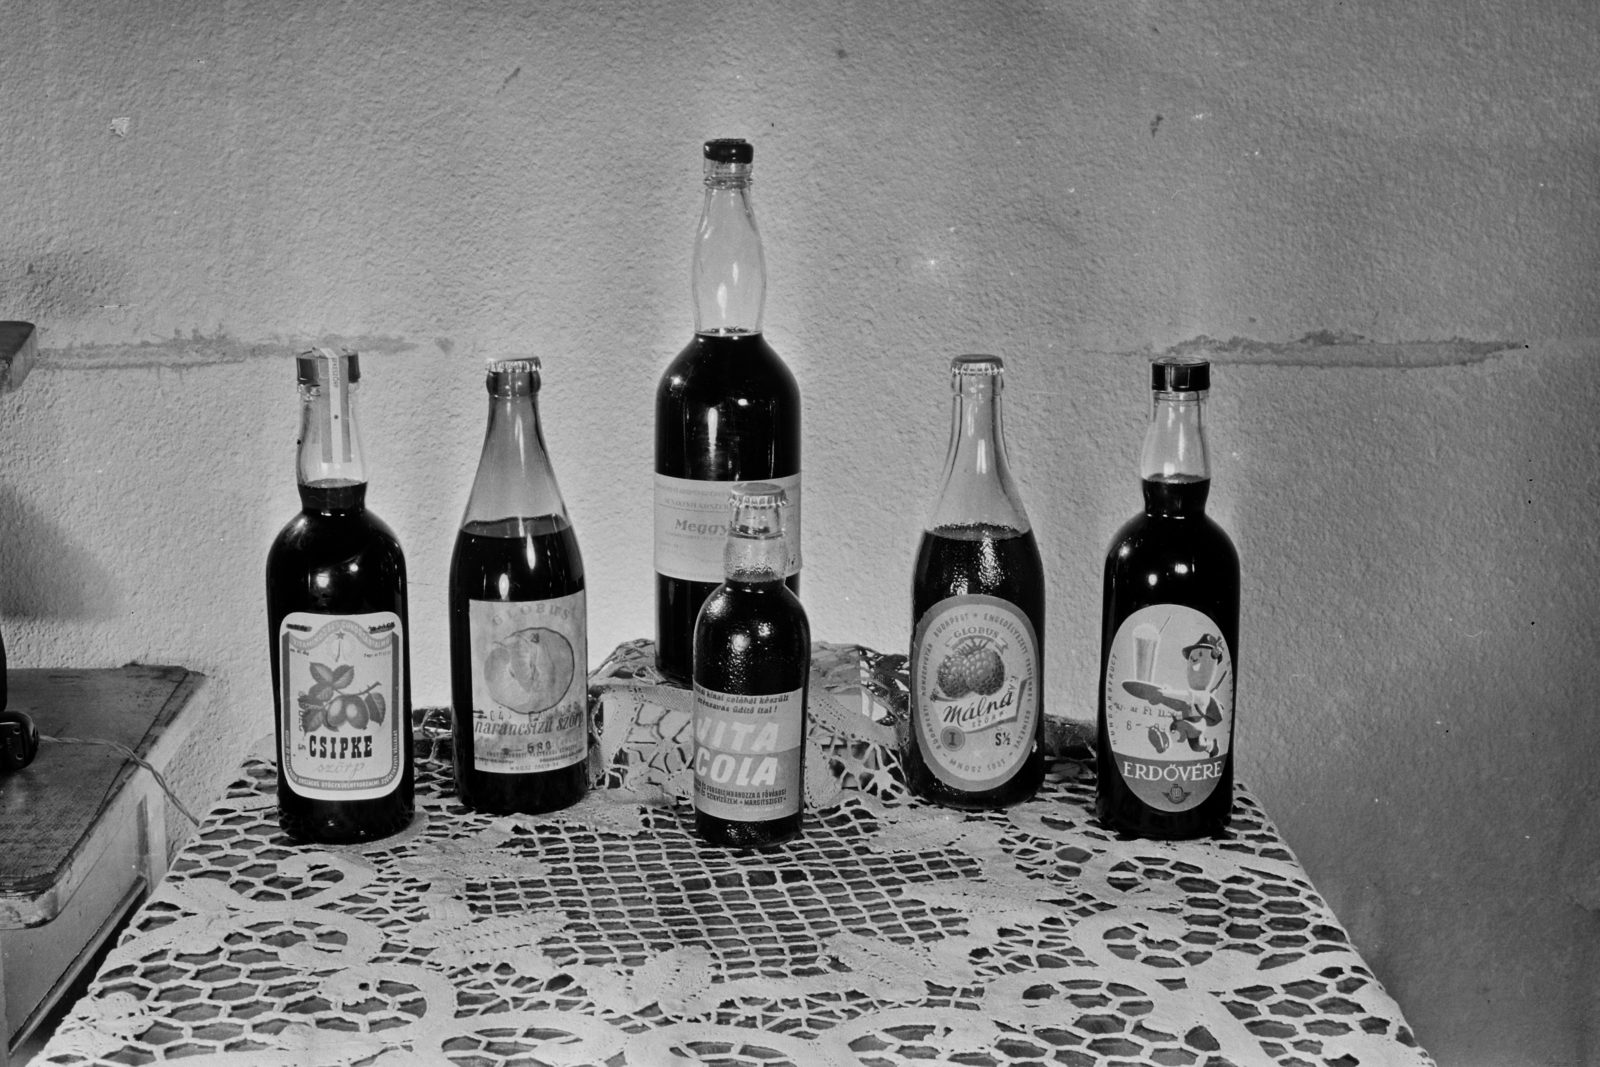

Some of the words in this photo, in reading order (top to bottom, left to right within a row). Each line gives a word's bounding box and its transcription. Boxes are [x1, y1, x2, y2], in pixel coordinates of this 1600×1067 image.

[492, 603, 571, 625] GLOBUS
[933, 613, 969, 638] BUDAPEST
[953, 626, 999, 639] GLOBUS
[943, 690, 1014, 727] Málna
[1107, 653, 1118, 745] HUNGAROFRUCT
[696, 716, 779, 752] VITA
[309, 735, 372, 759] CSIPKE
[696, 747, 778, 787] COLA
[949, 758, 981, 773] MNOSZ
[1123, 761, 1222, 781] ERDŐVÉRE
